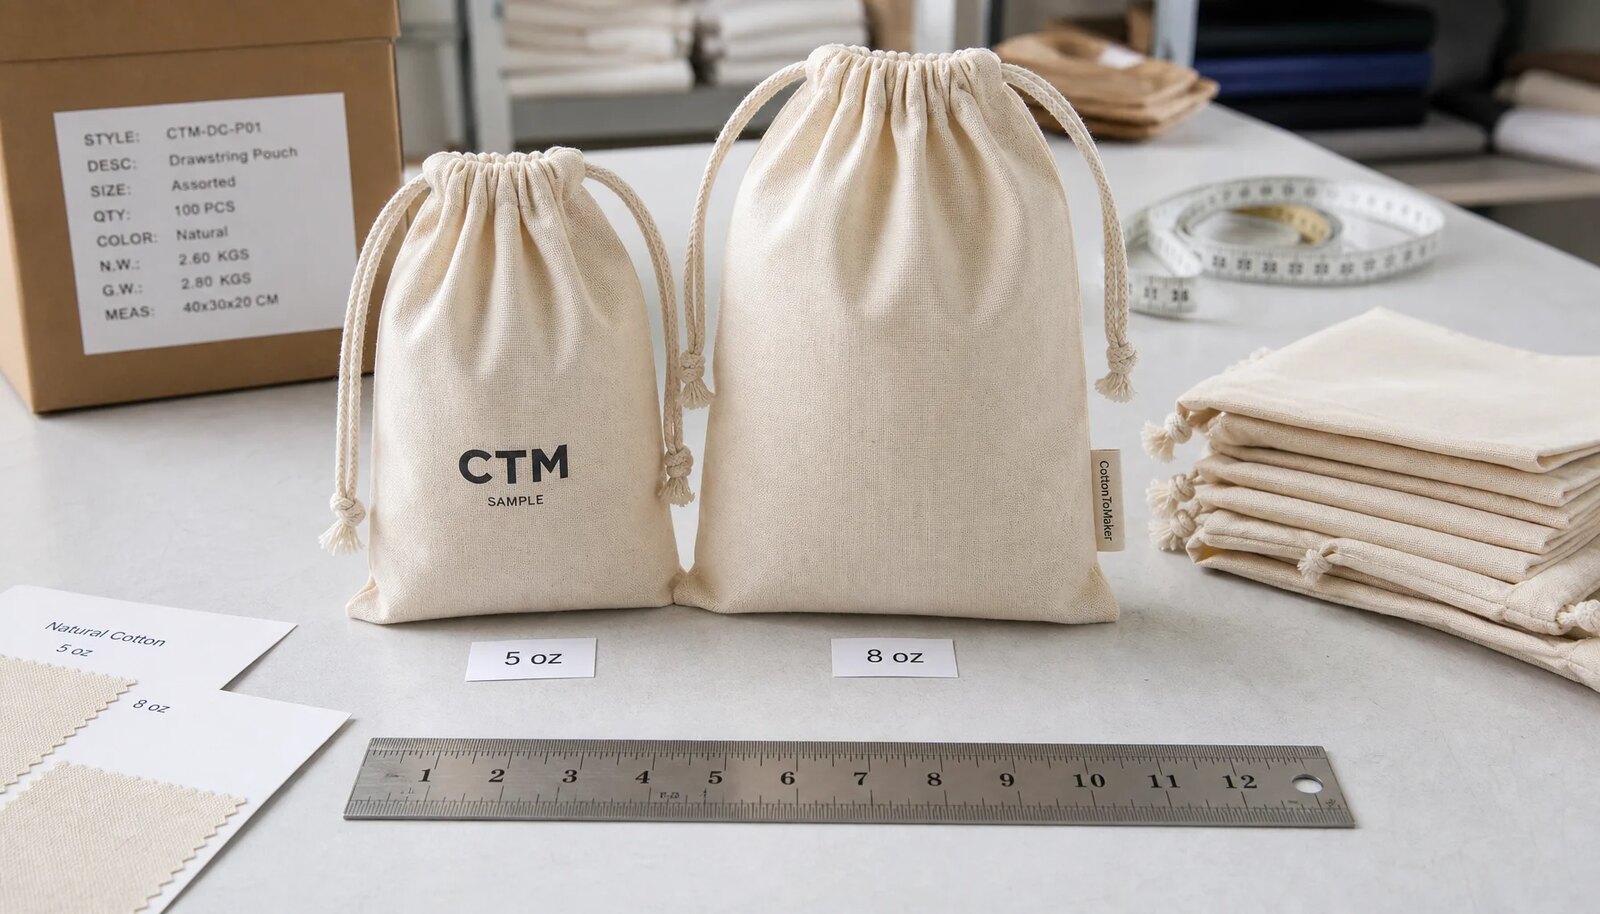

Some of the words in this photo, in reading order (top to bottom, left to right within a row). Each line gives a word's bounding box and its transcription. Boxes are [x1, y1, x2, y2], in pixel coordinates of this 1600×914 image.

[84, 131, 140, 146] STYLE:
[166, 122, 262, 140] CTM-DC-P01
[87, 158, 137, 172] DESC:
[169, 150, 248, 167] Drawstring
[253, 147, 298, 160] Pouch
[90, 183, 131, 198] SIZE:
[171, 176, 236, 192] Assorted
[93, 208, 131, 223] QTY:
[174, 203, 200, 217] 100
[204, 201, 235, 214] PCS
[96, 231, 158, 248] COLOR:
[176, 226, 228, 241] Natural
[100, 258, 140, 272] N.W.:
[178, 252, 210, 266] 2.60
[217, 249, 249, 262] KGS
[102, 282, 143, 297] G.W.:
[181, 276, 213, 290] 2.80
[220, 273, 251, 286] KGS
[105, 306, 154, 321] MEAS:
[183, 296, 252, 313] 40x30x20
[255, 294, 279, 307] CM
[458, 444, 569, 485] CTM
[487, 494, 544, 507] SAMPLE
[1099, 460, 1115, 541] CottonToMaker
[45, 621, 109, 638] Natural
[110, 631, 166, 647] Cotton
[56, 643, 72, 653] 5
[71, 648, 94, 657] oz
[504, 651, 521, 666] 5
[530, 653, 563, 665] oz
[866, 648, 883, 663] 8
[892, 653, 924, 664] oz
[132, 699, 147, 709] 8
[148, 703, 171, 714] oz
[418, 768, 431, 783] 1
[488, 768, 505, 783] 2
[561, 769, 578, 784] 3
[634, 770, 651, 785] 4
[708, 770, 723, 785] 5
[780, 771, 795, 786] 6
[853, 771, 868, 786] 7
[926, 772, 942, 787] 8
[999, 772, 1015, 787] 9
[1073, 773, 1106, 789] 10
[1148, 774, 1181, 789] 11
[1222, 774, 1258, 790] 12
